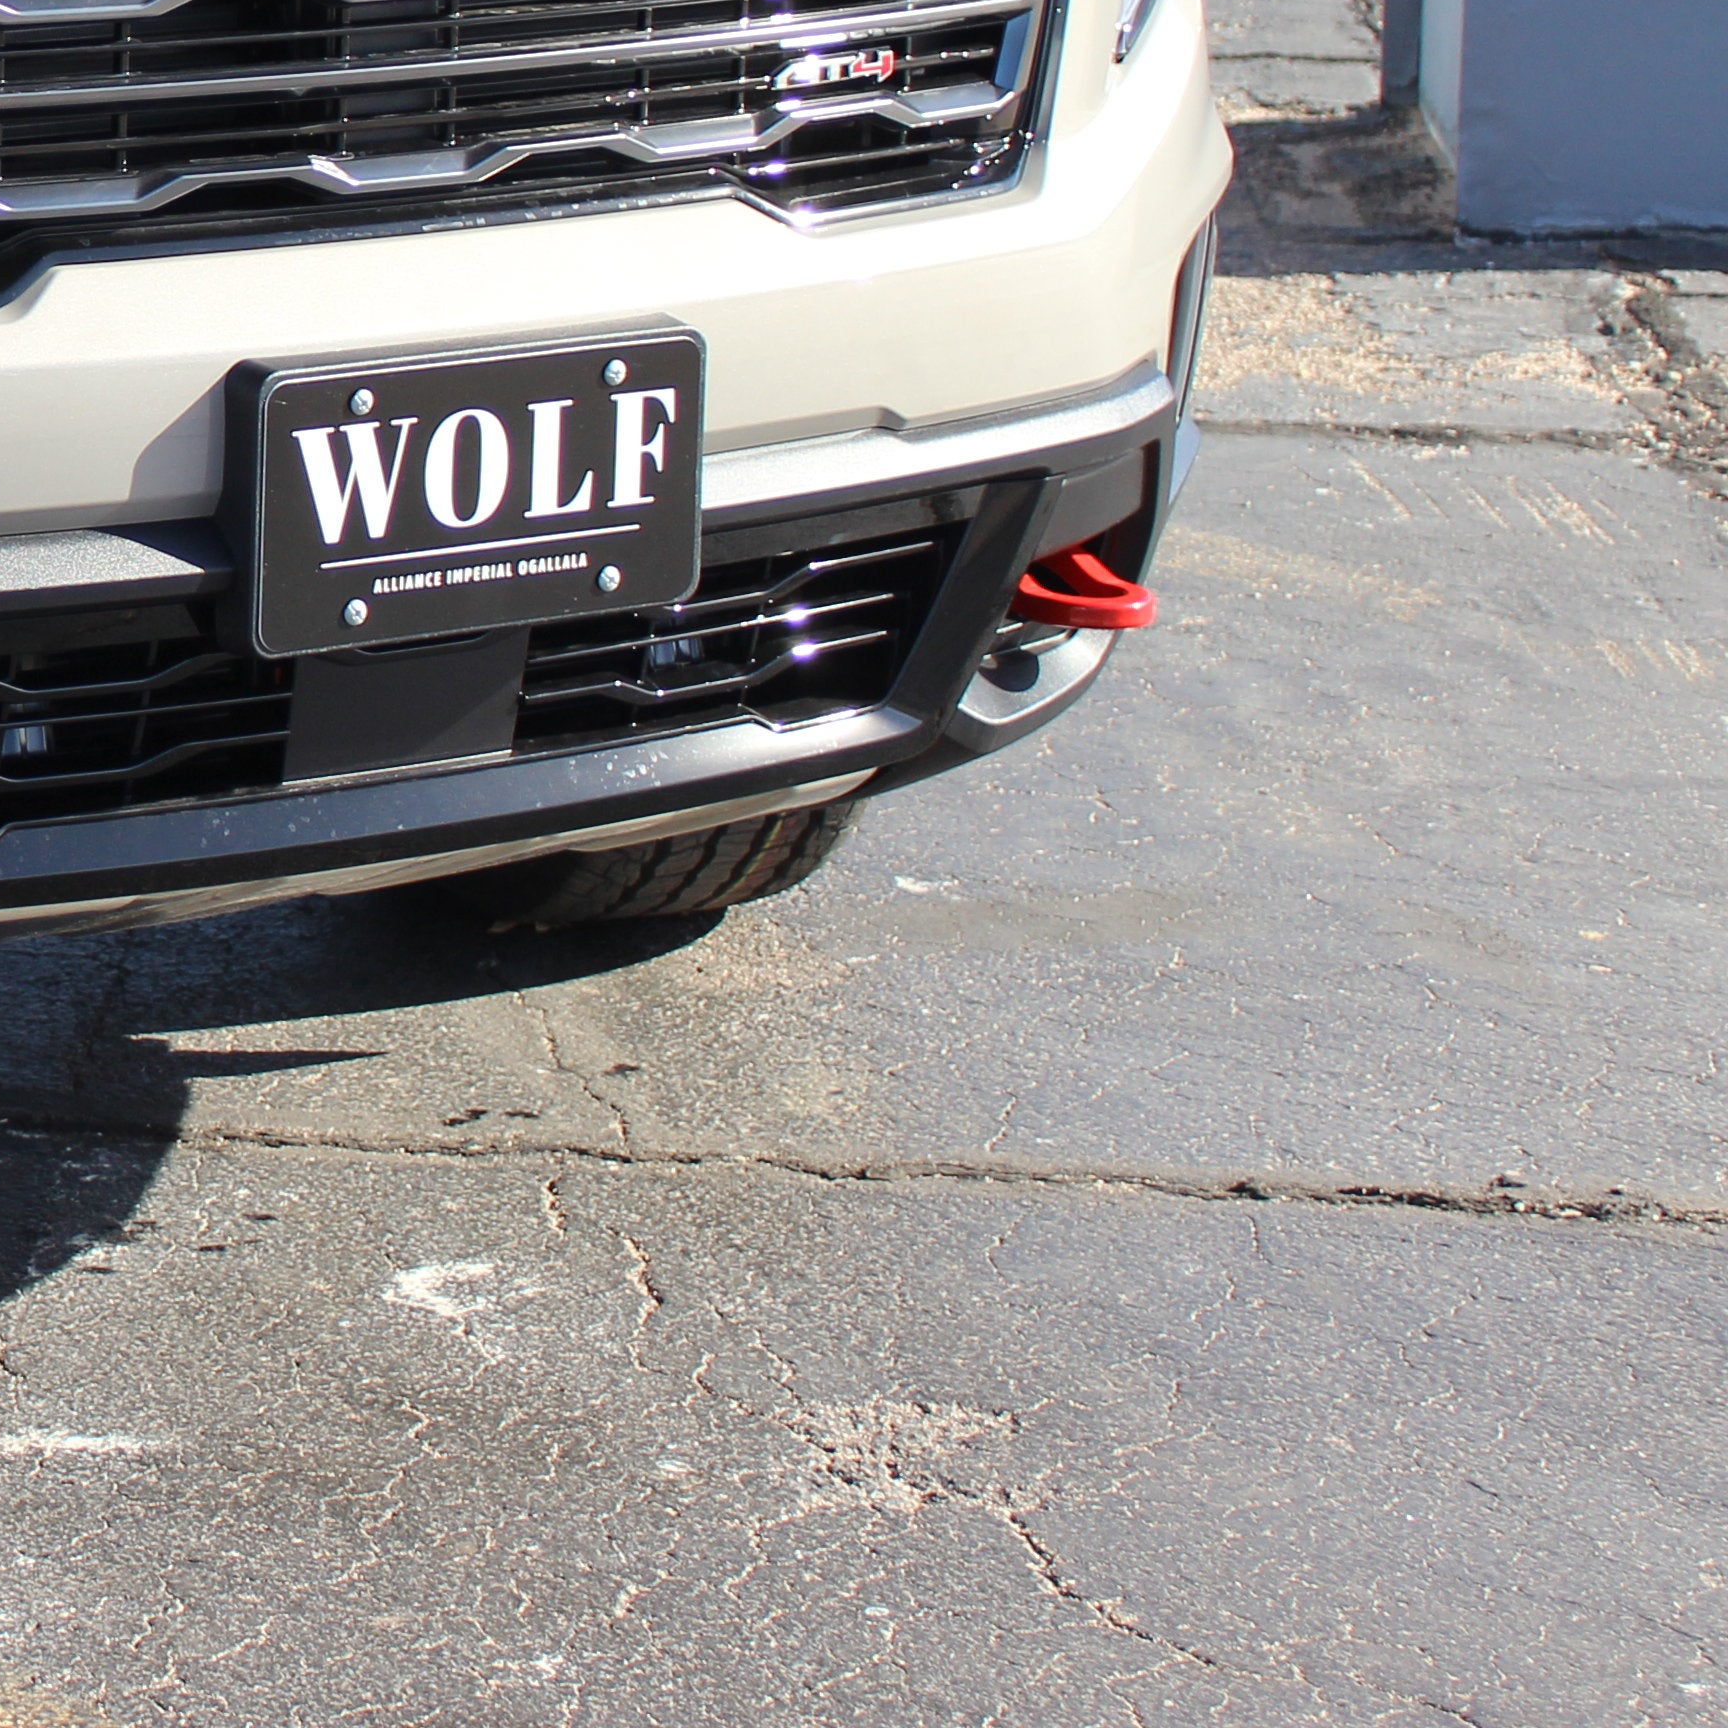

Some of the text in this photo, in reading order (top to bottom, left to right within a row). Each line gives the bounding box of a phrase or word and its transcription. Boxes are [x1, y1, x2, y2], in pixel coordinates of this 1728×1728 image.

[770, 49, 895, 91] AT4
[290, 387, 677, 546] WOLF
[372, 551, 589, 595] ALLIANCE IMPERIAL OGALLALA
